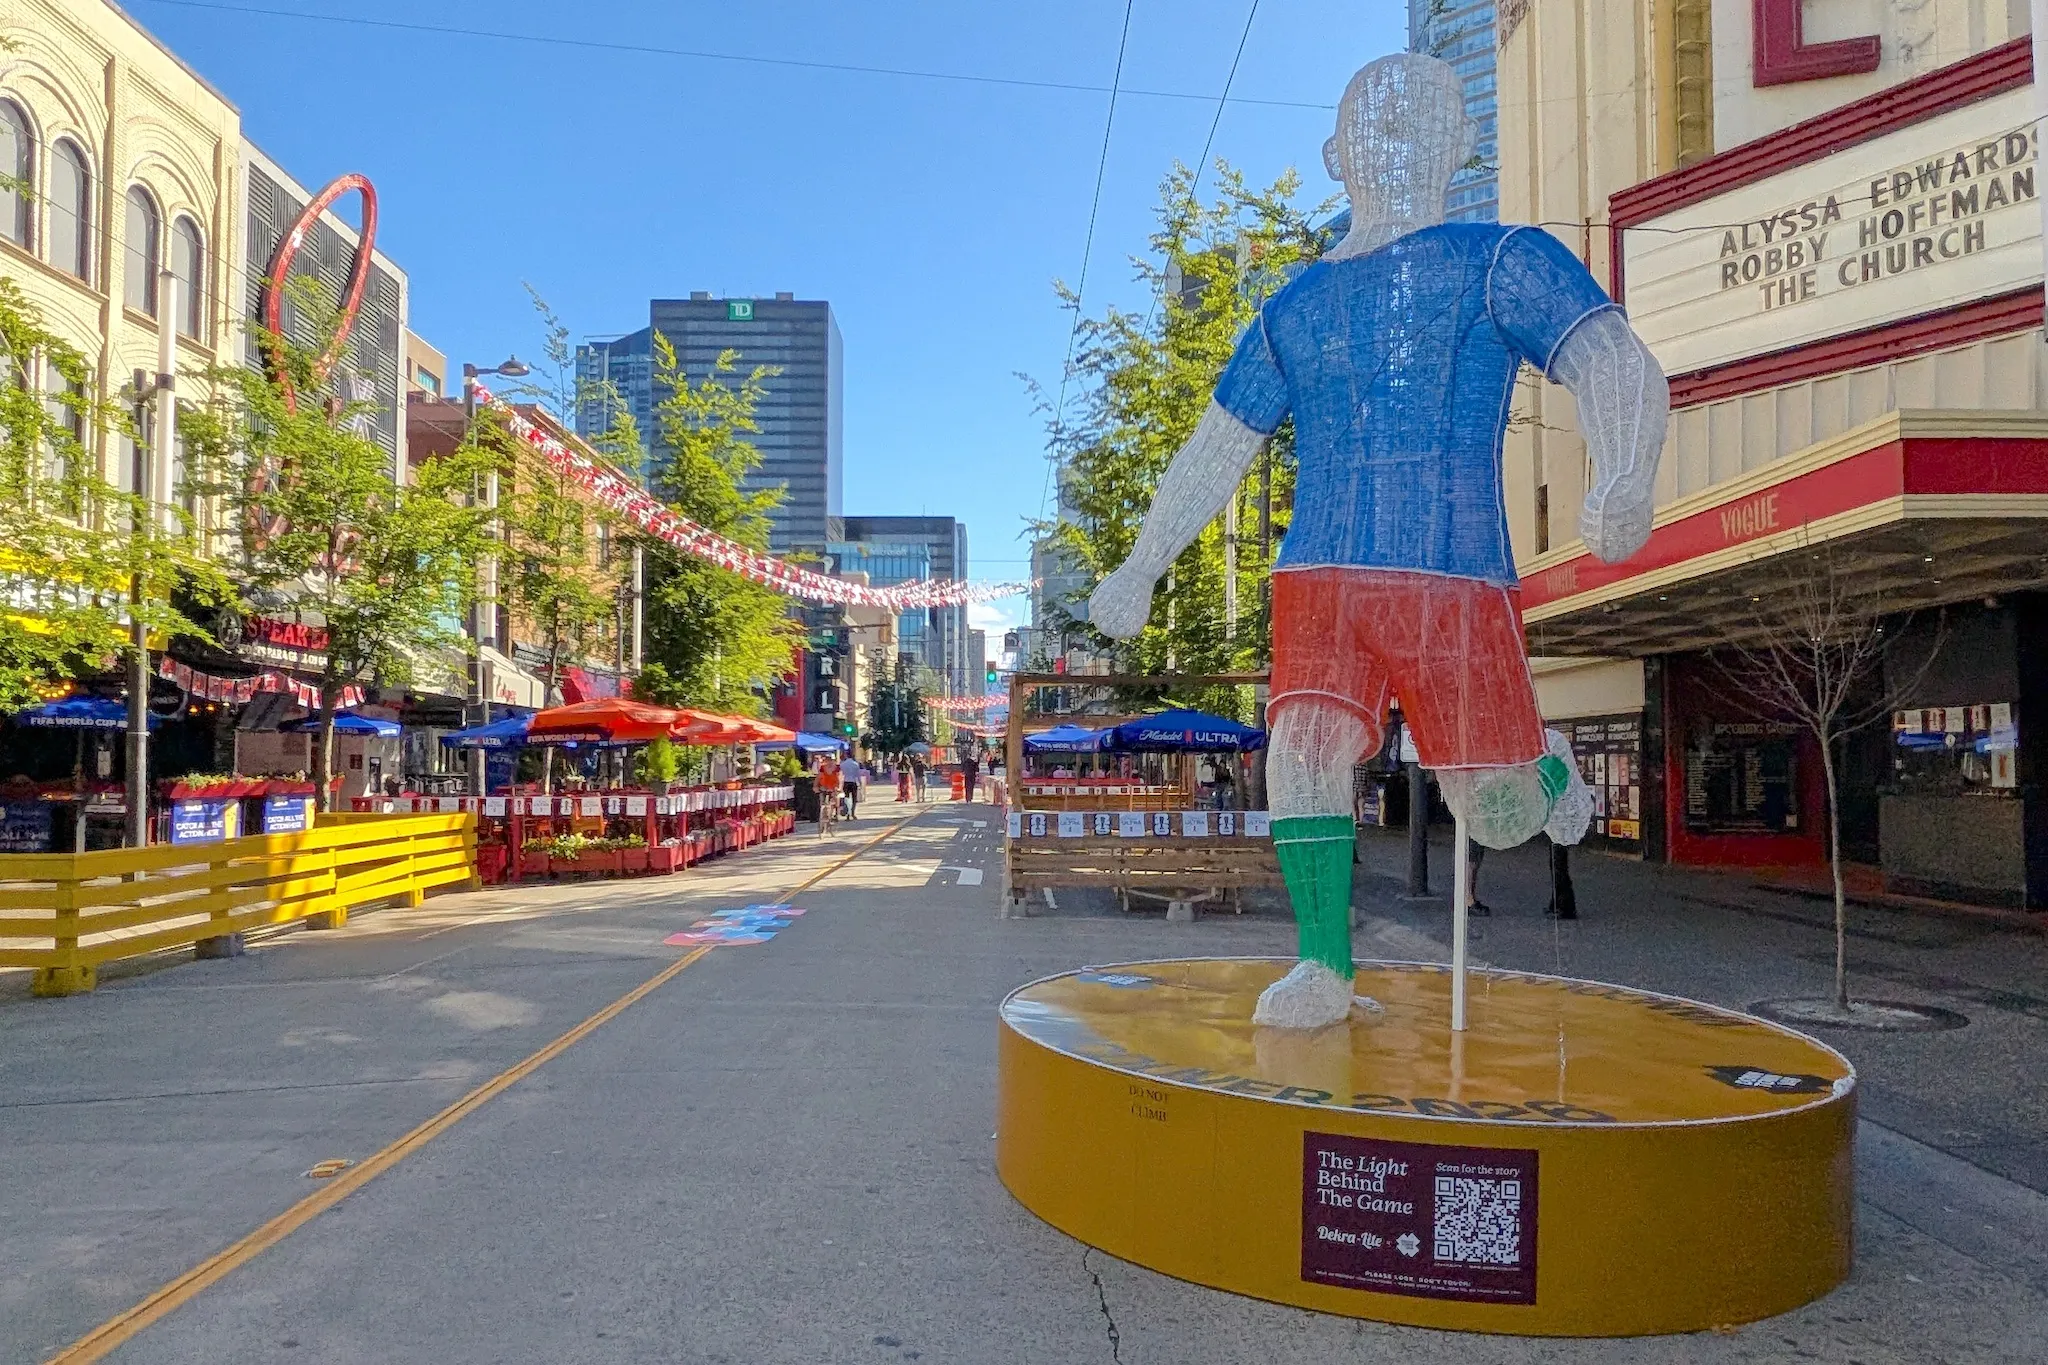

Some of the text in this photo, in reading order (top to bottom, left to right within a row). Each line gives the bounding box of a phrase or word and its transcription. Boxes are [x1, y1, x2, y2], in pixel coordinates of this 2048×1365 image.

[1720, 196, 1842, 258] ALYSSA
[1722, 167, 2035, 289] ROBBY HOFFMAN
[1760, 220, 1985, 310] THE CHURCH
[731, 303, 750, 316] TD
[1721, 493, 1780, 540] VOGUE
[1545, 564, 1579, 594] VOGUE
[56, 717, 94, 726] WORLD
[95, 718, 116, 727] CUP
[1195, 732, 1239, 745] ULTRA
[1145, 1089, 1168, 1103] NOT
[1317, 1150, 1409, 1178] The Light
[1435, 1162, 1520, 1178] Scan for the story
[1317, 1169, 1385, 1193] Behind
[1317, 1188, 1413, 1215] The Game
[1317, 1226, 1382, 1249] Dekra-Lite
